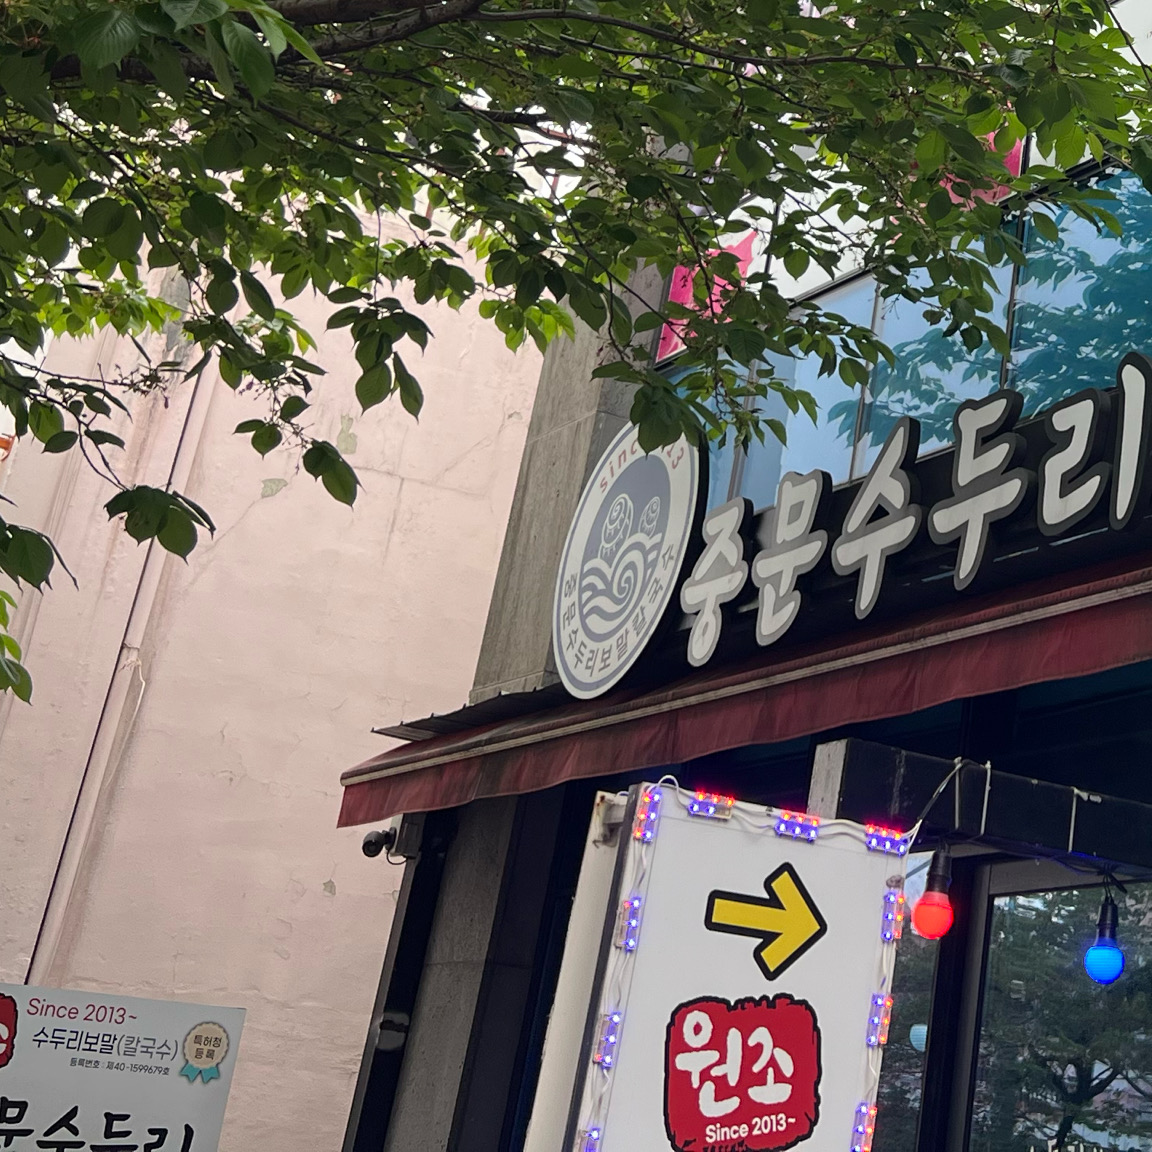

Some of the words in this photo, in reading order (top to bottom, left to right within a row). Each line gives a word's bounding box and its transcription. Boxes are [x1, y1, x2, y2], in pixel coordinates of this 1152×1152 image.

[26, 998, 79, 1020] Since
[83, 1004, 138, 1025] 2013~
[705, 1122, 748, 1144] Since
[752, 1113, 797, 1137] 2013~
